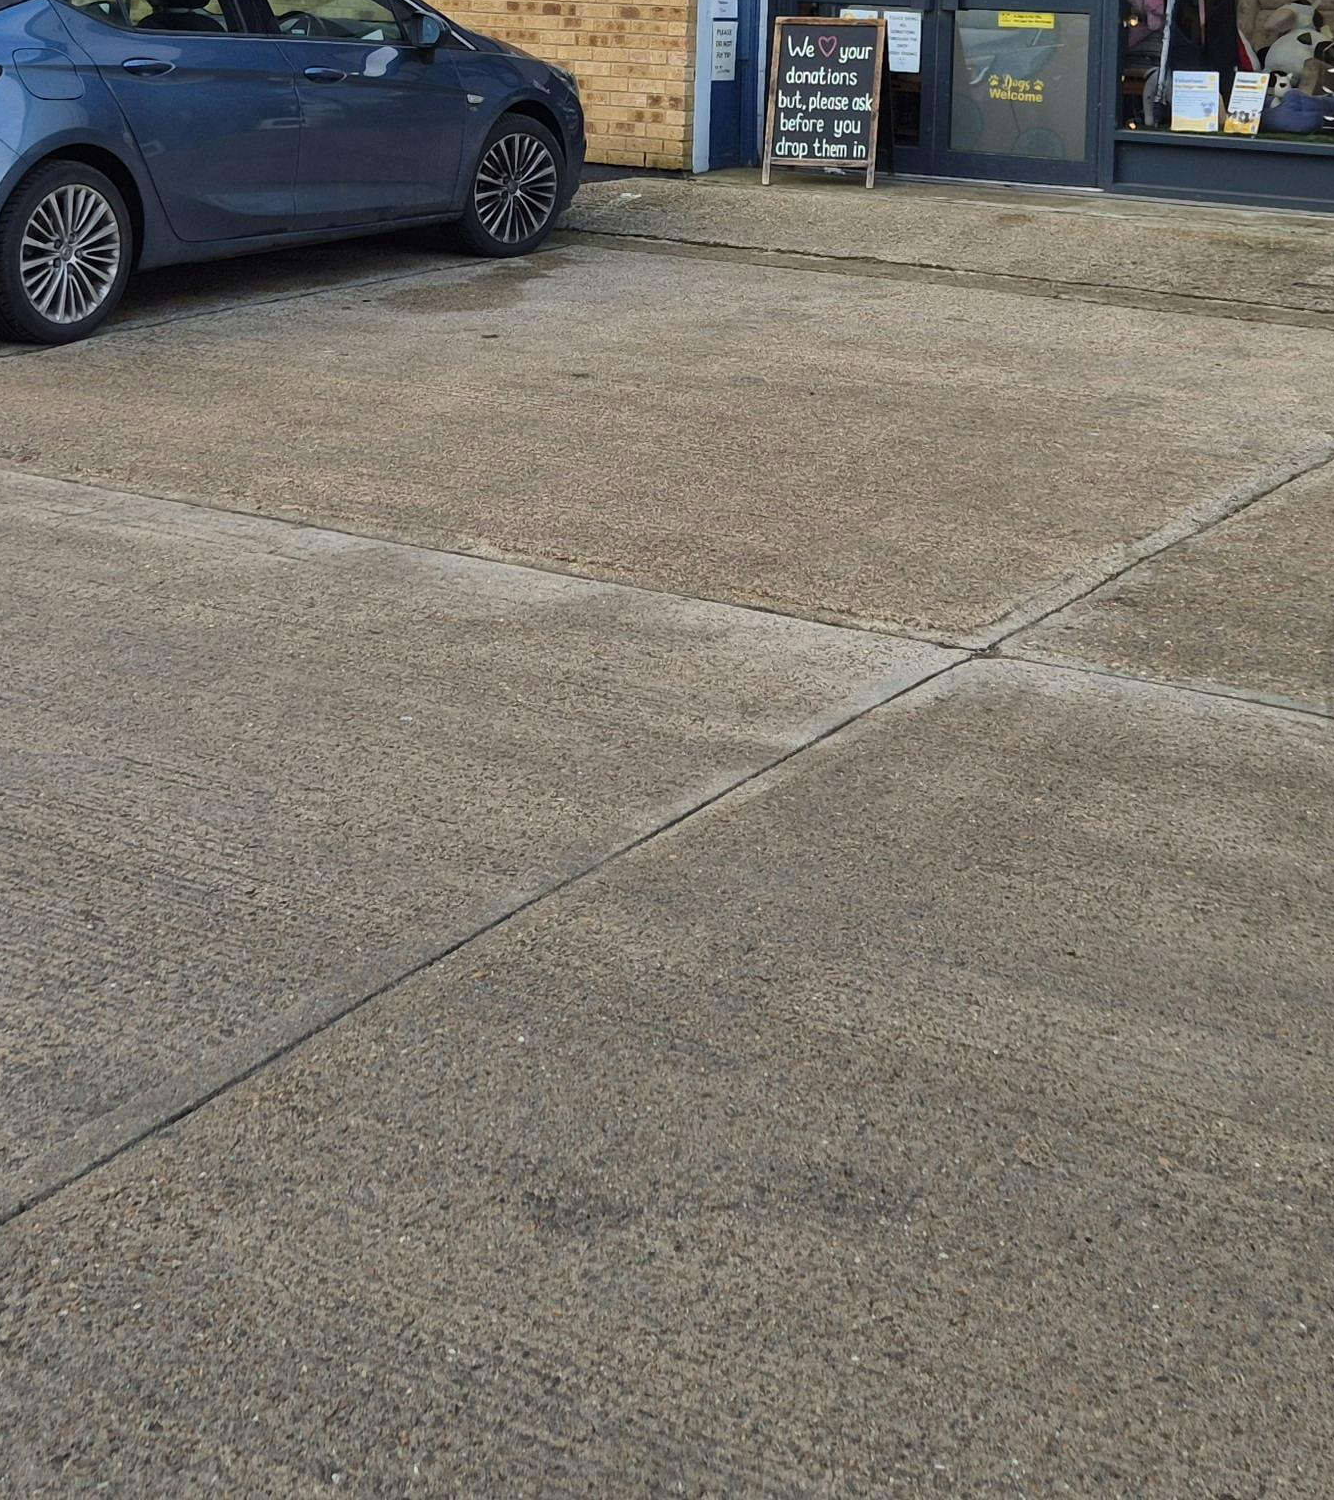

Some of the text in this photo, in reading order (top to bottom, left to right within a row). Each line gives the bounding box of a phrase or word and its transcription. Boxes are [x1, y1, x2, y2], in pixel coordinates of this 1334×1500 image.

[787, 35, 873, 63] We your
[785, 65, 858, 86] donations
[1002, 74, 1031, 92] Dogs
[778, 89, 873, 112] but, please ask
[989, 88, 1043, 103] Welcome
[780, 112, 861, 138] before you
[775, 136, 866, 159] drop them in
